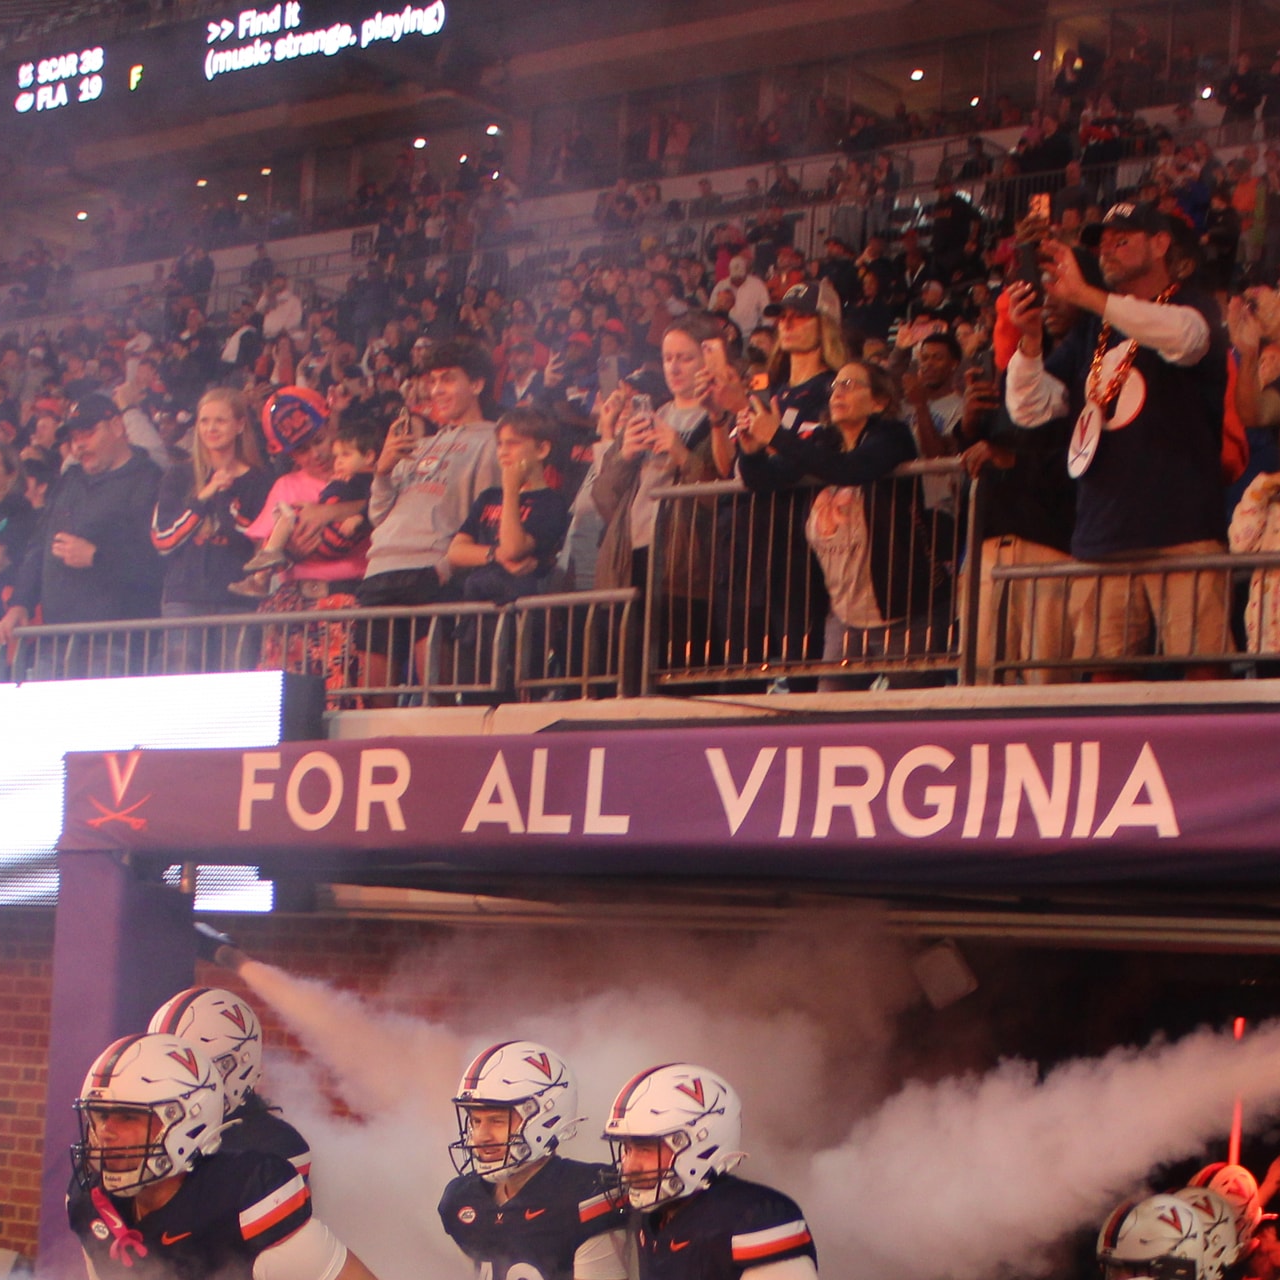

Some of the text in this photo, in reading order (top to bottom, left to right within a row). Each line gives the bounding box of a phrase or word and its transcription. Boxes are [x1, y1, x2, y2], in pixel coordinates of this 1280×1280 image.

[238, 3, 282, 40] Find
[284, 2, 301, 28] it
[205, 39, 272, 81] (music
[360, 0, 447, 49] playing)
[37, 53, 78, 84] SCAR
[129, 64, 143, 91] F
[37, 75, 103, 111] FLA 19
[238, 748, 411, 832] FOR
[461, 748, 630, 834] ALL
[705, 742, 1179, 839] VIRGINIA
